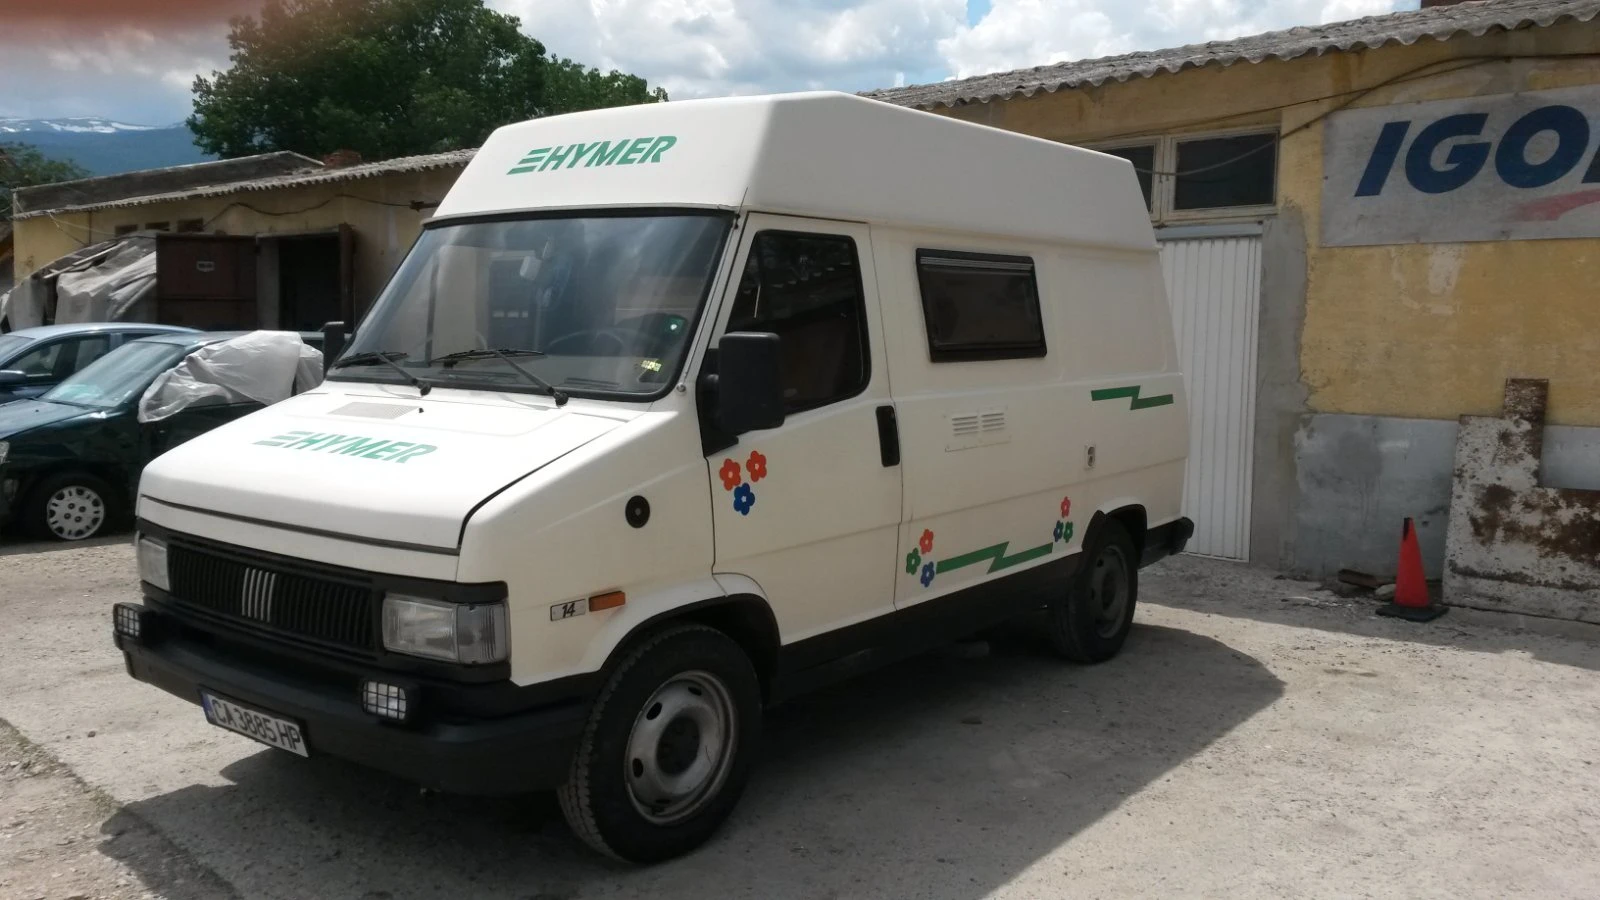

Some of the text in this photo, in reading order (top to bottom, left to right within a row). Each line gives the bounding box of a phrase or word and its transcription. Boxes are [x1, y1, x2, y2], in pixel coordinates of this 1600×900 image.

[537, 135, 677, 173] HYMER
[1354, 105, 1600, 197] IGO
[282, 432, 438, 464] HYMER
[562, 602, 576, 618] 14
